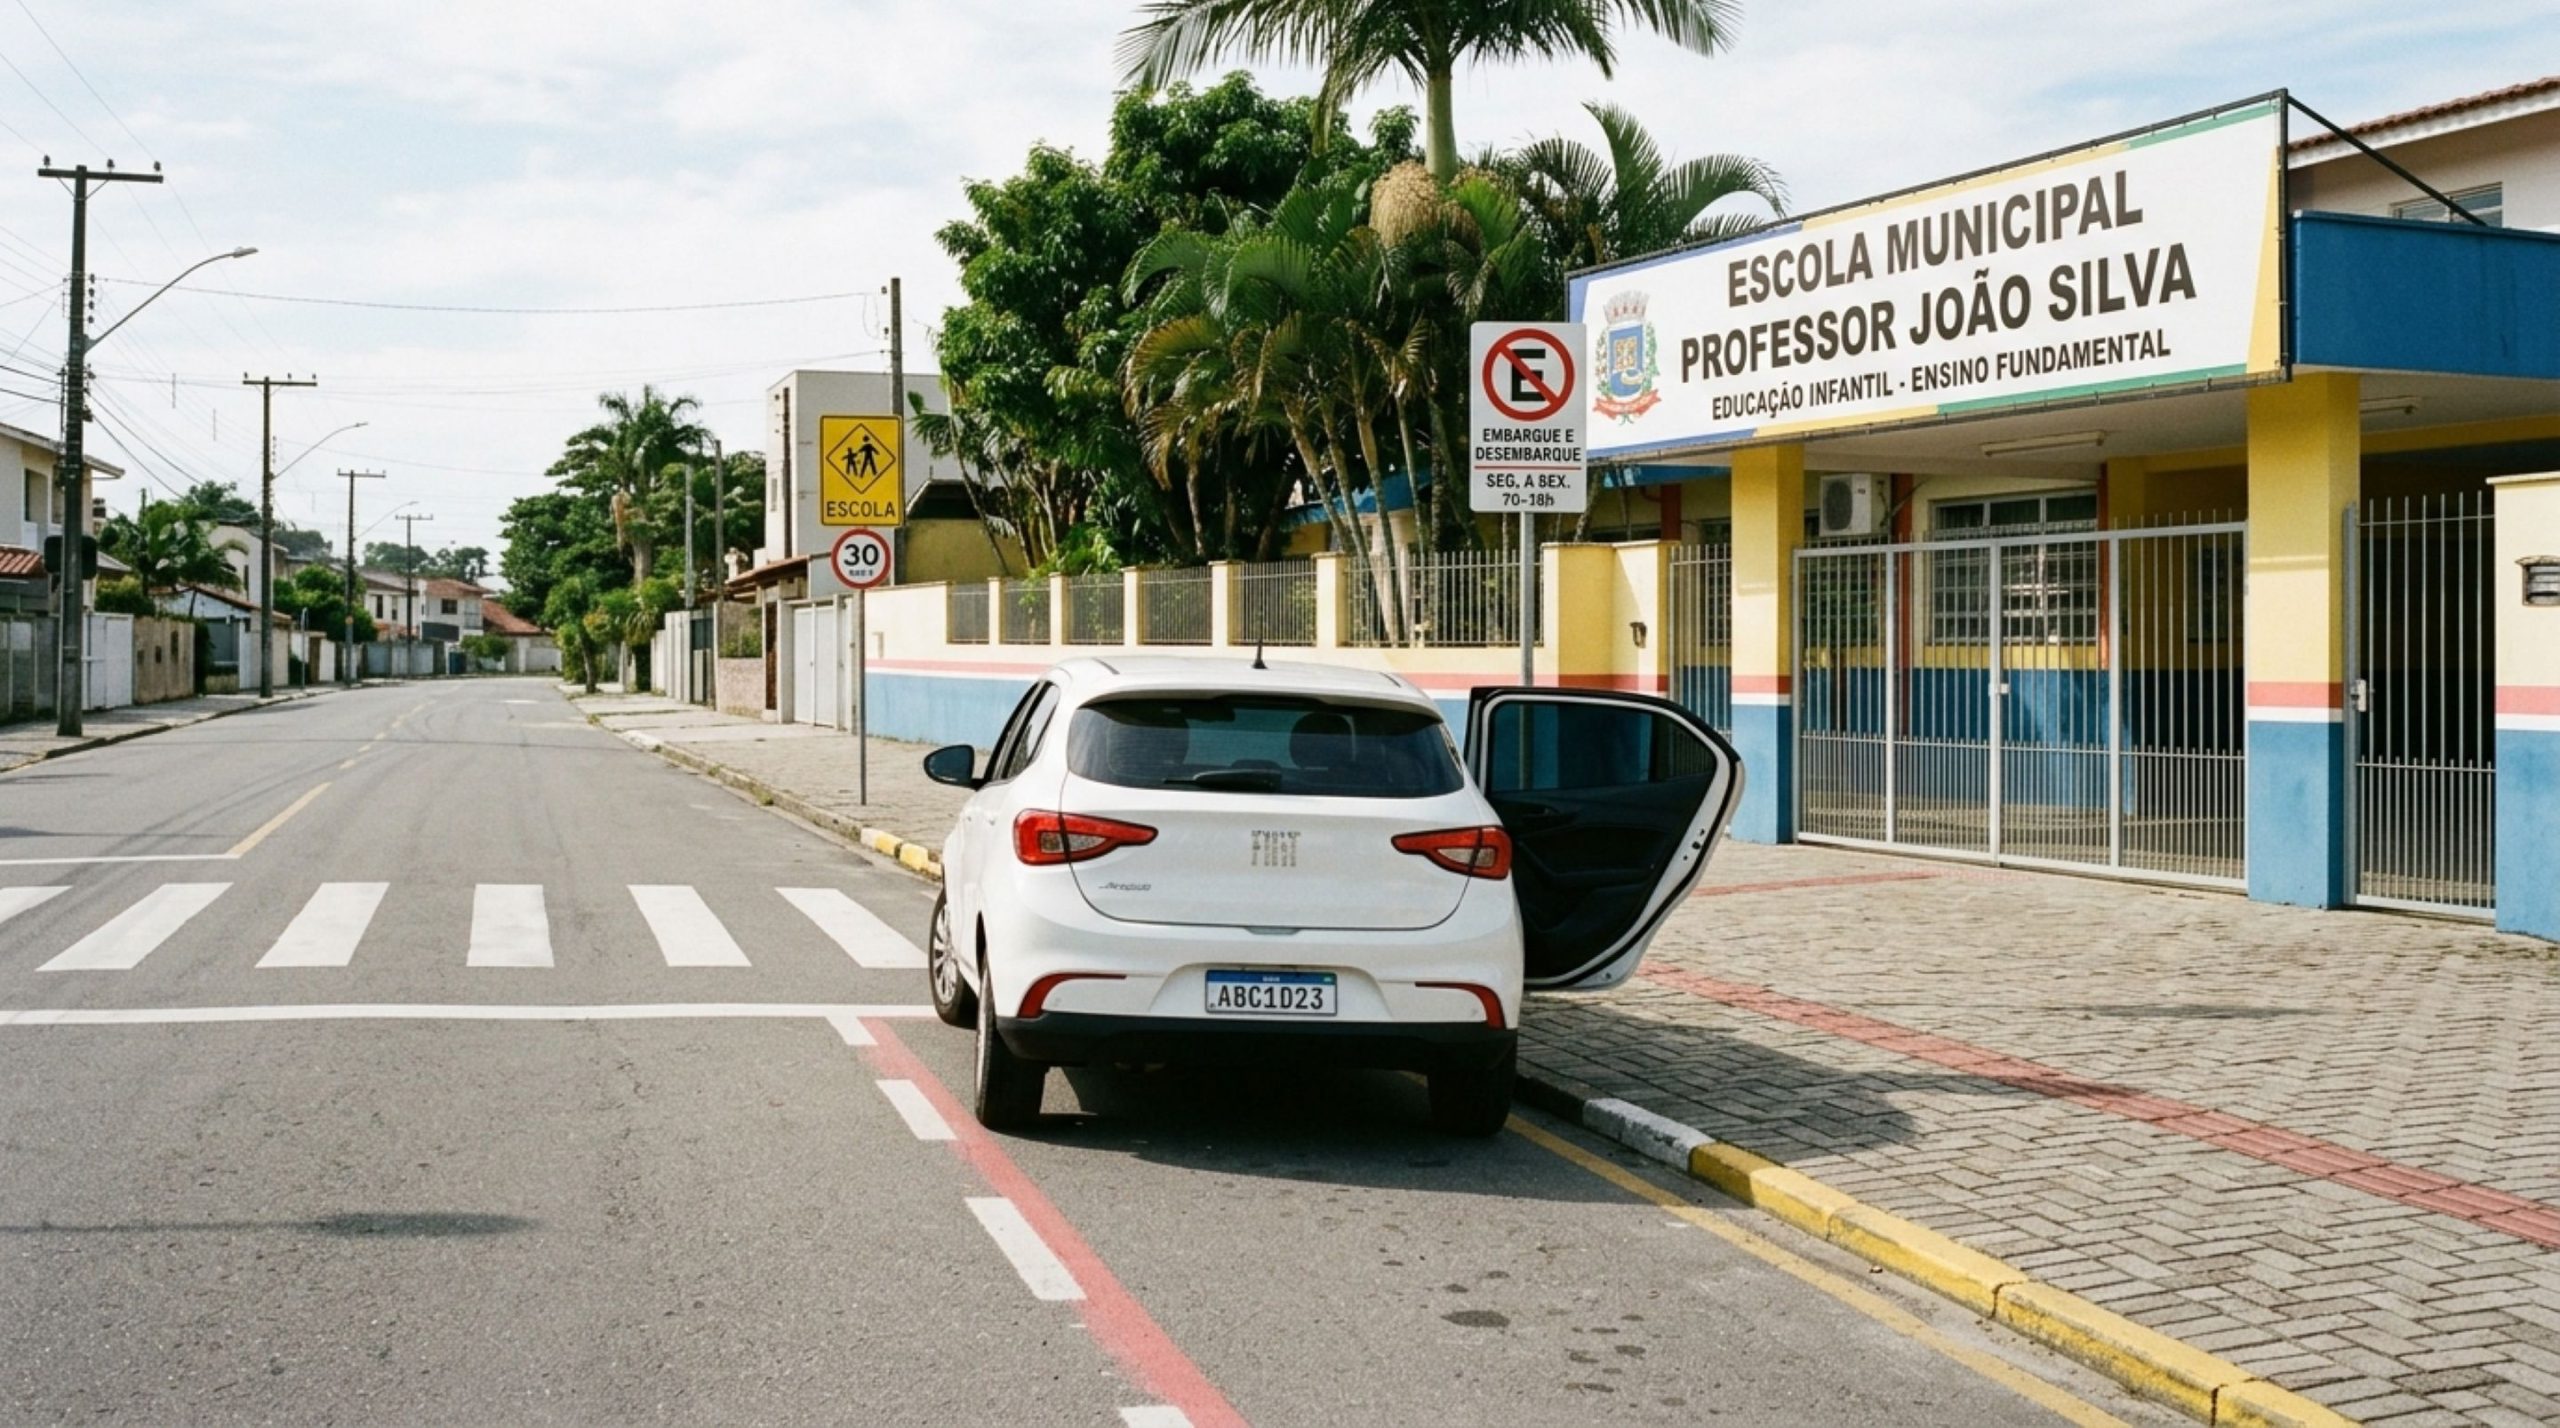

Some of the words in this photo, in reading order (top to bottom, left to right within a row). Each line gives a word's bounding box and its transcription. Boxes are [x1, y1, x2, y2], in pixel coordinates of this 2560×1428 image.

[1729, 232, 1874, 307] ESCOLA
[1887, 170, 2144, 275] MUNICIPAL
[1681, 300, 1897, 383] PROFESSOR
[1909, 267, 2031, 346] JOÃO
[2048, 242, 2197, 322] SILVA
[1712, 378, 1804, 421] EDUCAÇÃO
[1809, 371, 1894, 407] INFANTIL
[1911, 350, 1989, 393] ENSINO
[1996, 328, 2171, 381] FUNDAMENTAL
[1565, 429, 1575, 443] E
[1475, 446, 1581, 462] DESEMBARQUE
[1486, 473, 1520, 489] SEG.
[1524, 474, 1534, 488] A
[826, 501, 896, 517] ESCOLA
[843, 543, 879, 567] 30
[1217, 984, 1323, 1011] ABC1D23
